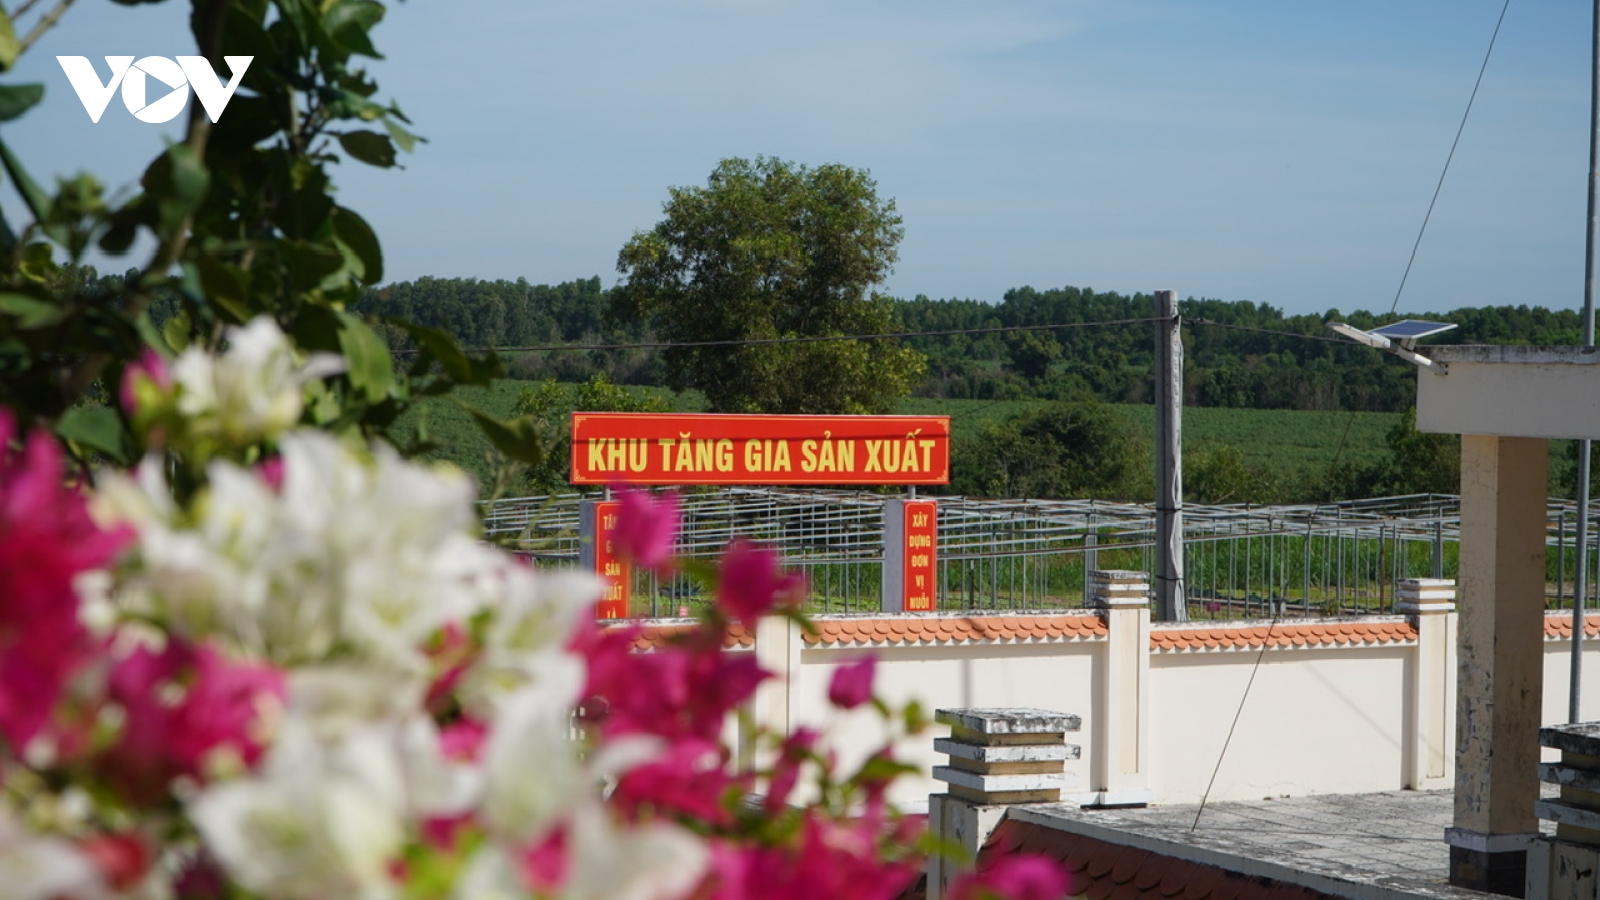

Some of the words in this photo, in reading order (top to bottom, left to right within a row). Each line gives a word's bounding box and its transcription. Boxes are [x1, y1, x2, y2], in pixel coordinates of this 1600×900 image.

[588, 437, 648, 472] KHU
[658, 431, 734, 473] TĂNG
[744, 438, 792, 473] GIA
[800, 430, 855, 473] SẢN
[864, 428, 936, 473] XUẤT
[912, 512, 929, 527] XÂY
[909, 534, 931, 550] DỰNG
[911, 554, 929, 568] ĐƠN
[915, 575, 924, 590] VỊ
